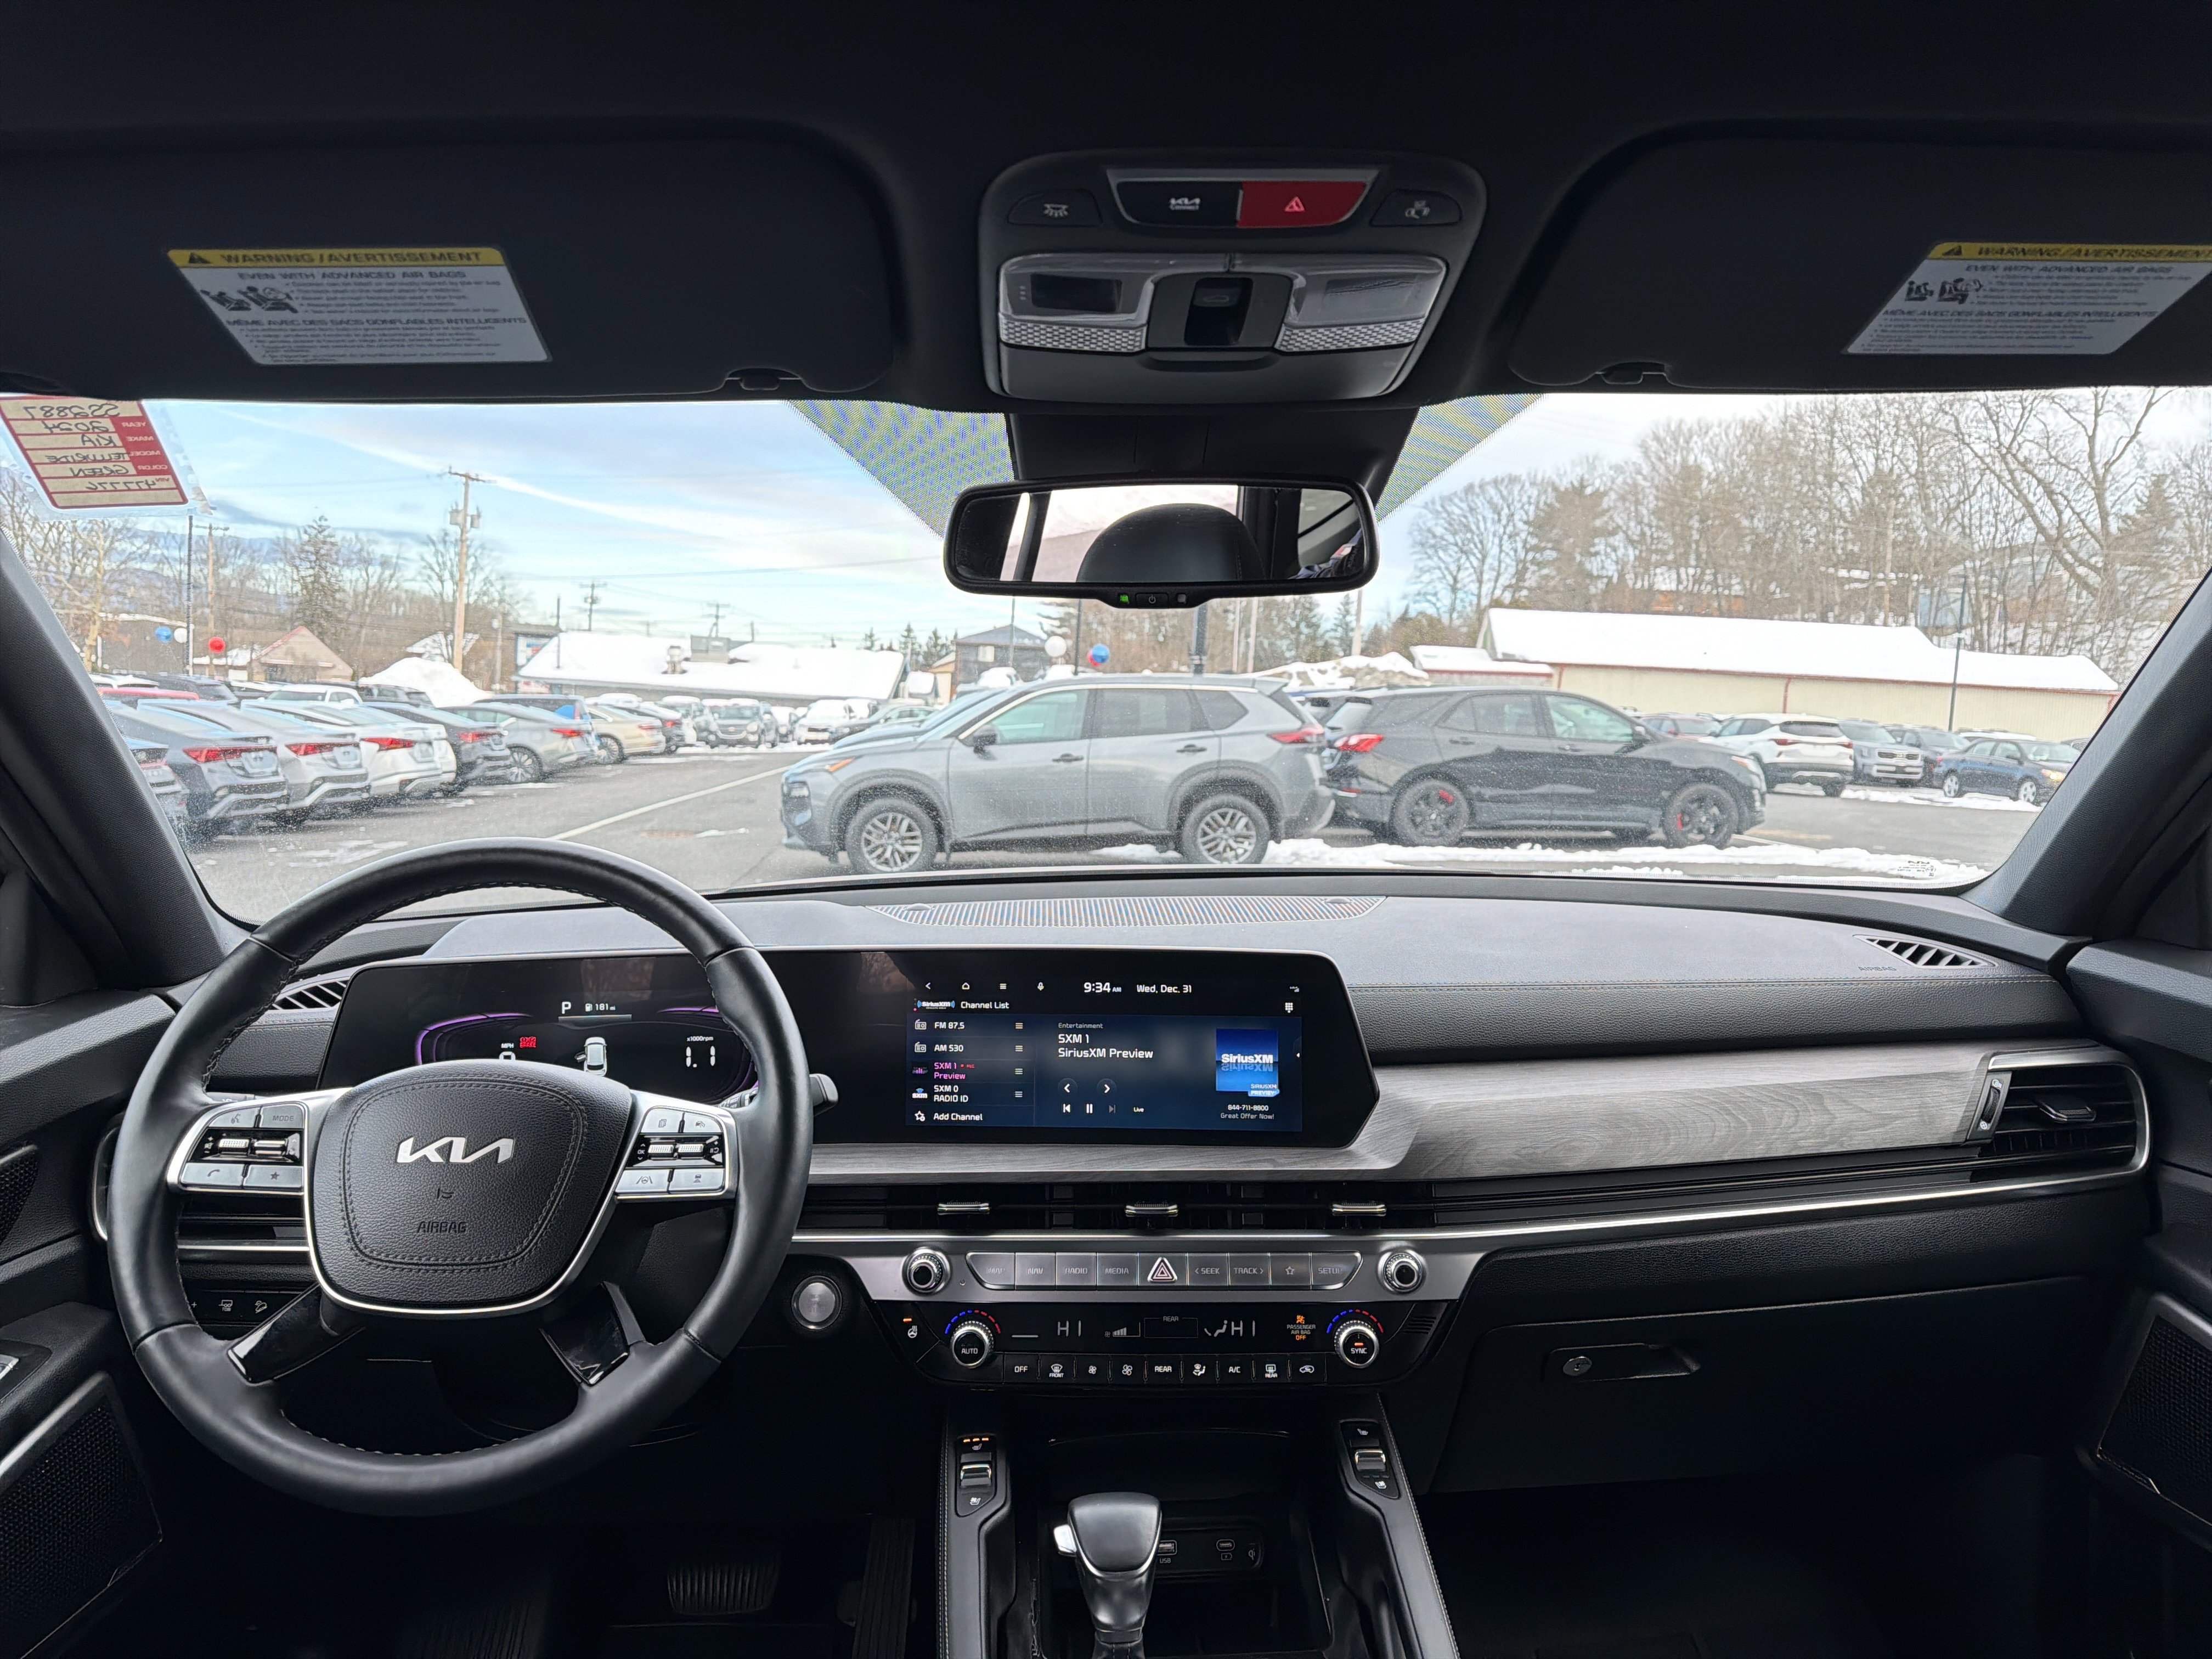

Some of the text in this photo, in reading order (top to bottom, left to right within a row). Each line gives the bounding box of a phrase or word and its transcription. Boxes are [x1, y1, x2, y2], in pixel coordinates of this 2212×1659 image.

[1084, 982, 1111, 992] 9:34
[562, 1001, 571, 1014] P
[1058, 1034, 1089, 1043] SXM 1
[1058, 1048, 1153, 1058] SiriusXM Preview
[1221, 1054, 1273, 1064] SiriusXM
[417, 1221, 467, 1233] AIRBAG
